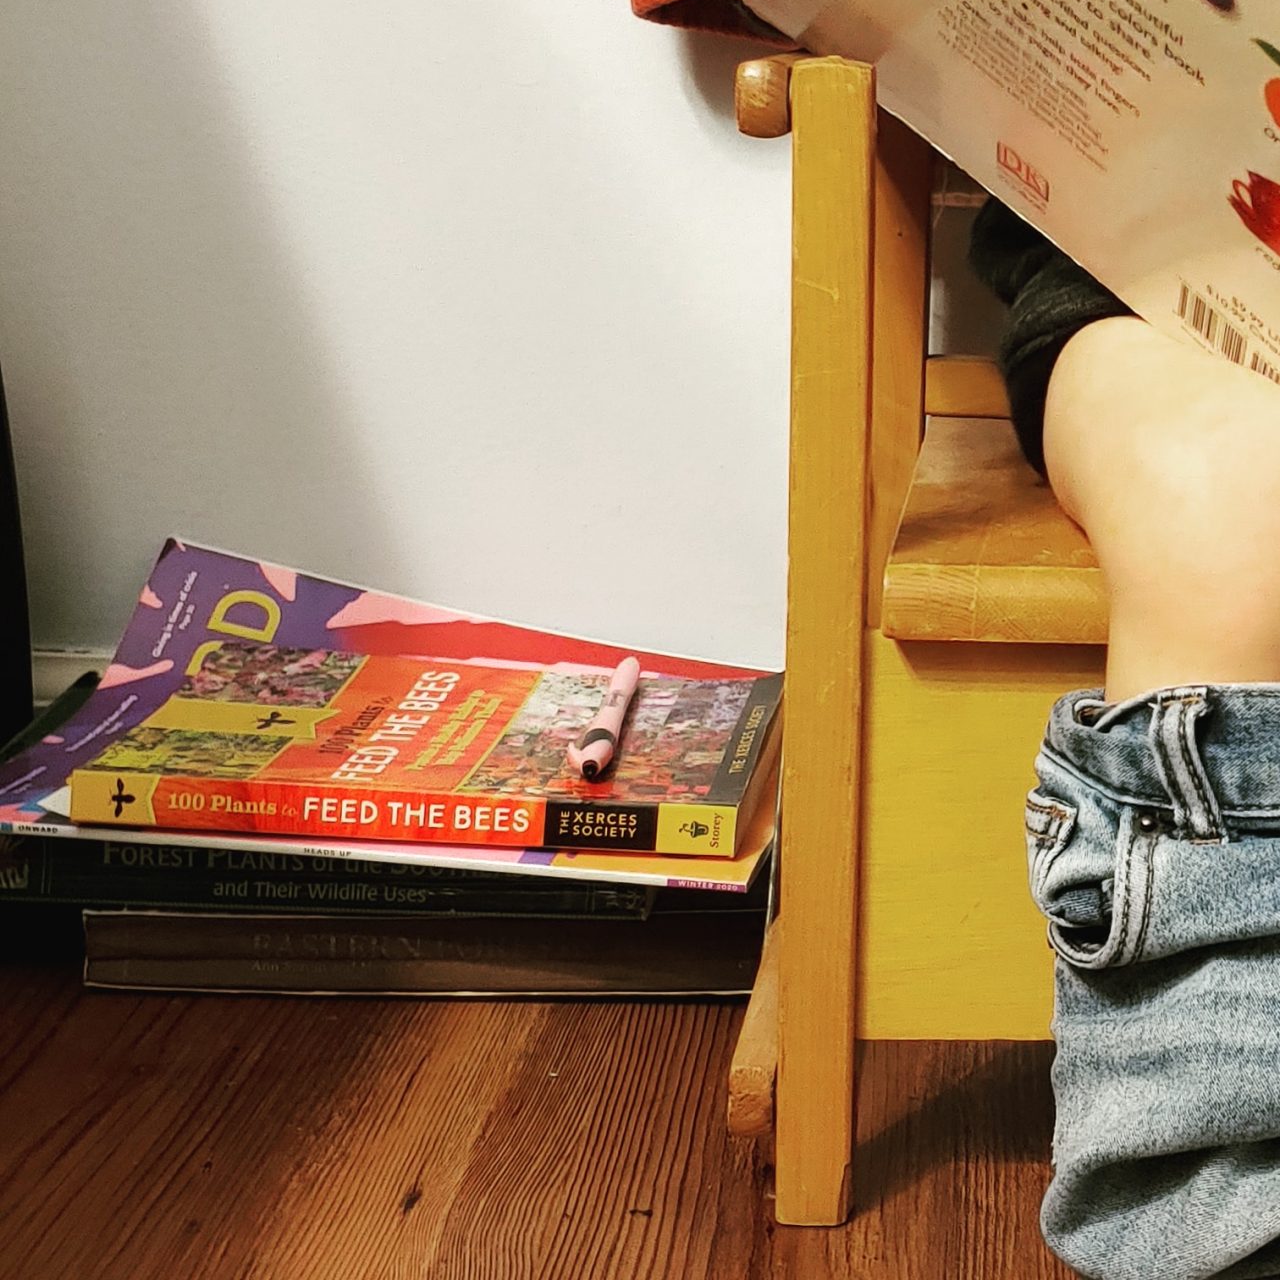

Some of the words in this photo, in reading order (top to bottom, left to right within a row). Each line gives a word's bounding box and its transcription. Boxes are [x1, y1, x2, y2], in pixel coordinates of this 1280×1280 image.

[1087, 0, 1102, 21] to
[1055, 15, 1075, 38] and
[1092, 29, 1150, 83] questions
[1109, 0, 1157, 48] colors
[1164, 41, 1204, 87] book
[1002, 146, 1043, 191] DK
[397, 670, 461, 711] BEES
[368, 712, 431, 742] THE
[331, 745, 400, 781] FEED
[167, 792, 205, 812] 100
[209, 795, 277, 816] Plants
[280, 805, 297, 818] to
[303, 797, 379, 824] FEED
[387, 801, 446, 829] THE
[453, 805, 530, 833] BEES
[559, 810, 571, 835] THE
[573, 811, 637, 826] XERCES
[573, 824, 637, 839] SOCIETY
[710, 813, 724, 849] Storey
[103, 842, 198, 869] FOREST
[207, 848, 304, 873] PLANTS
[303, 846, 337, 856] HEADS
[213, 880, 248, 898] and
[256, 882, 302, 899] Their
[308, 882, 378, 903] Wildlife
[384, 885, 428, 903] Uses
[677, 879, 713, 890] WINTER
